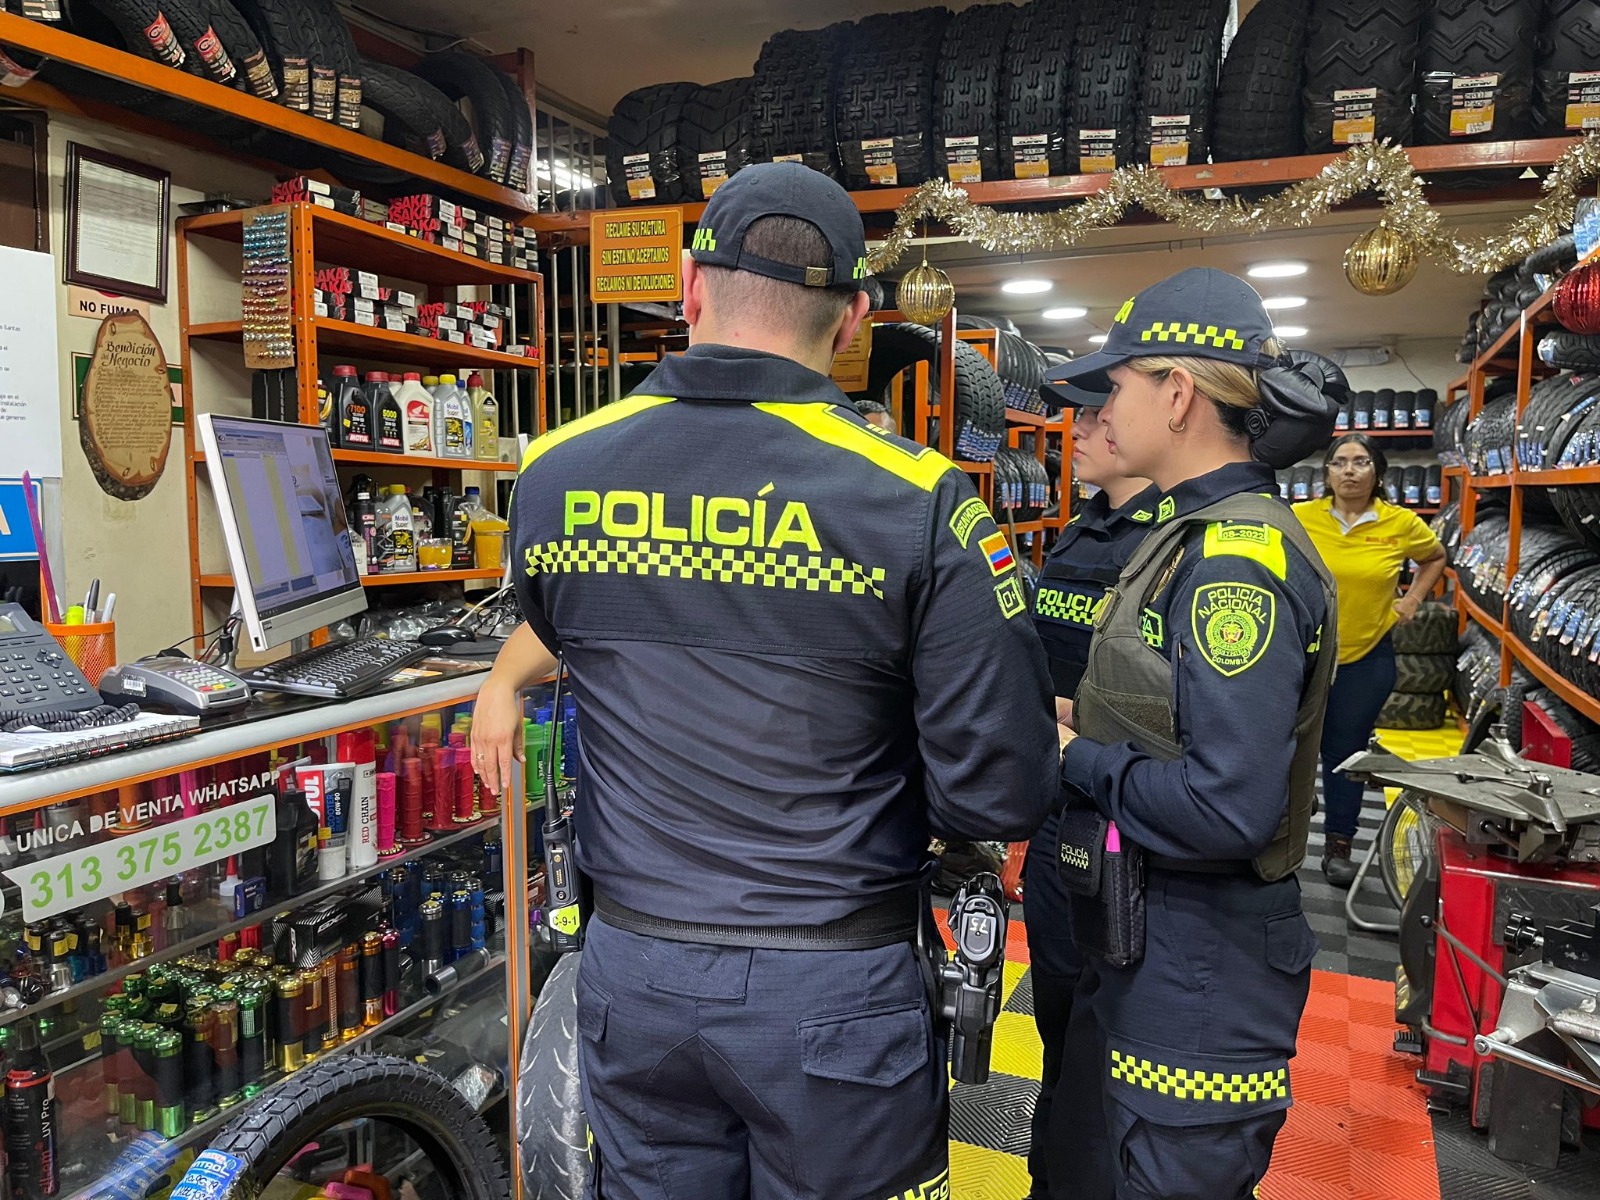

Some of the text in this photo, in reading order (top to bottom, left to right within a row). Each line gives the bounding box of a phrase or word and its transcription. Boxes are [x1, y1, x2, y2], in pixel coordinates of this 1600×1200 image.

[605, 219, 666, 238] RECLAME SU FACTURA
[602, 246, 669, 265] SIN ESTA NO ACEPTAMOS
[596, 273, 675, 292] RECLAMOS NI DEVOLUCIONES
[80, 300, 139, 315] NO FUMA
[106, 341, 156, 356] Bendición
[101, 352, 151, 368] Negocio
[382, 409, 397, 418] 5000
[350, 434, 369, 443] MOTUL
[382, 437, 400, 446] MOTUL
[564, 481, 822, 552] POLICÍA
[1222, 530, 1265, 540] 08-2022
[1207, 587, 1263, 607] POLICÍA
[1197, 598, 1268, 625] NACIONAL
[1212, 655, 1248, 665] COLOMBIA
[305, 776, 321, 820] TUL
[17, 820, 85, 853] UNICA
[89, 811, 118, 833] DE
[122, 796, 184, 824] VENTA
[188, 771, 281, 807] WHATSAPP
[361, 796, 370, 844] RED CHAIN
[30, 804, 269, 909] 313 375 2387
[1061, 843, 1089, 860] POLICÍA
[552, 915, 577, 927] C-9-1
[41, 1098, 50, 1119] Pro
[41, 1121, 51, 1138] UV
